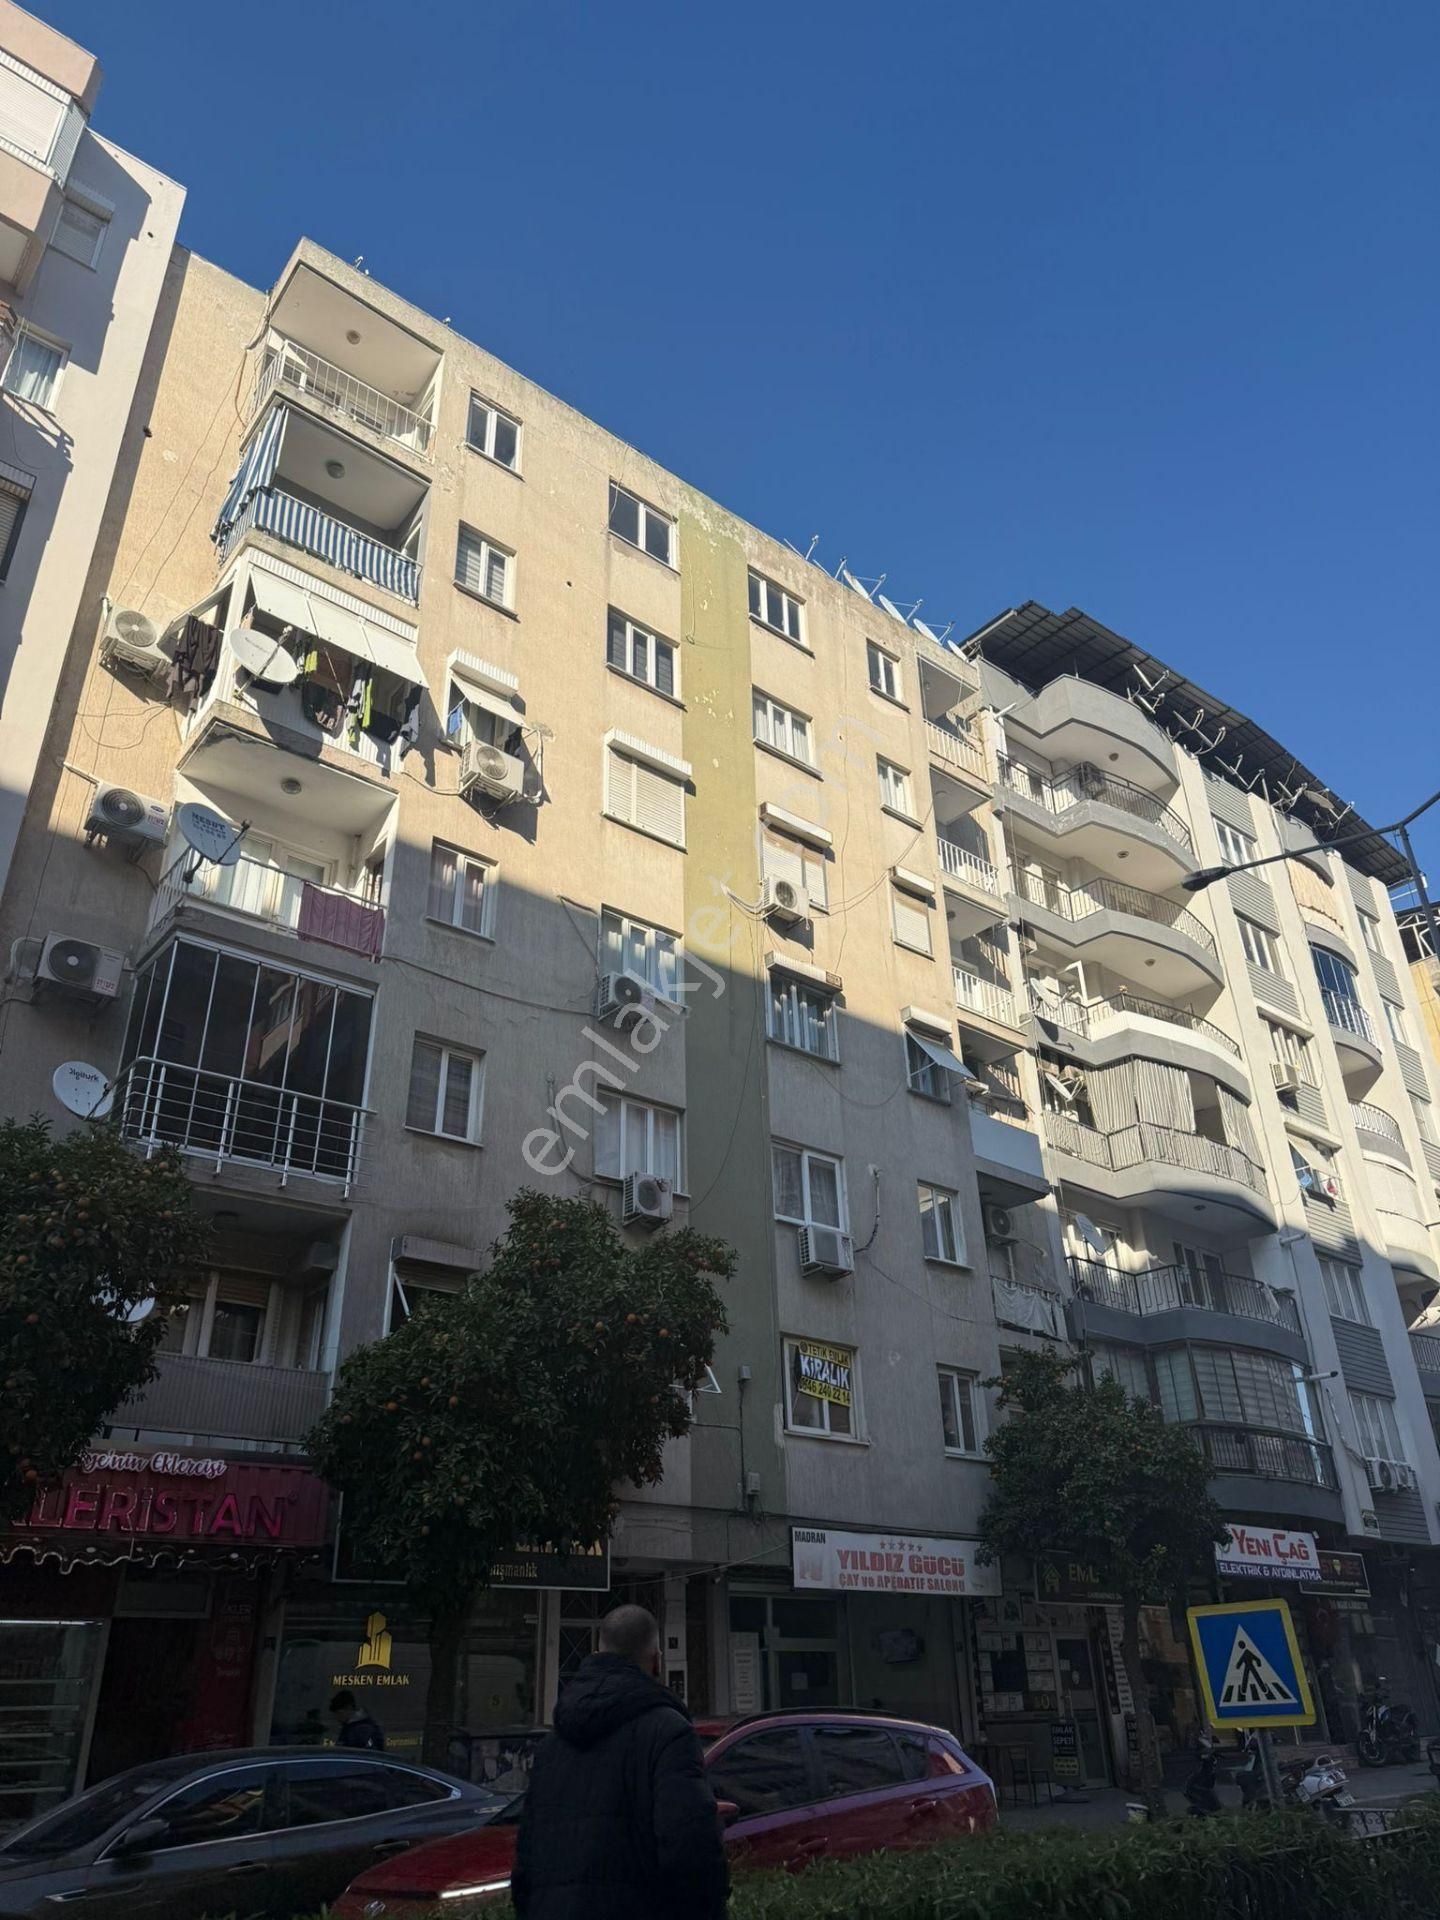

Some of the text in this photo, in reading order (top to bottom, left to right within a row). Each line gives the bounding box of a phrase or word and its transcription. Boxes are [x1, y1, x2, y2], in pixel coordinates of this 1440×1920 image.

[794, 1530, 826, 1545] MADRAN
[1272, 1533, 1310, 1564] ÇAĞ
[837, 1549, 966, 1577] YILDIZ GÜCÜ
[839, 1573, 859, 1588] ÇAY
[927, 1577, 966, 1592] SALONU
[1271, 1567, 1322, 1581] AYDINLATMA
[332, 1674, 410, 1686] MESKEN EMLAK
